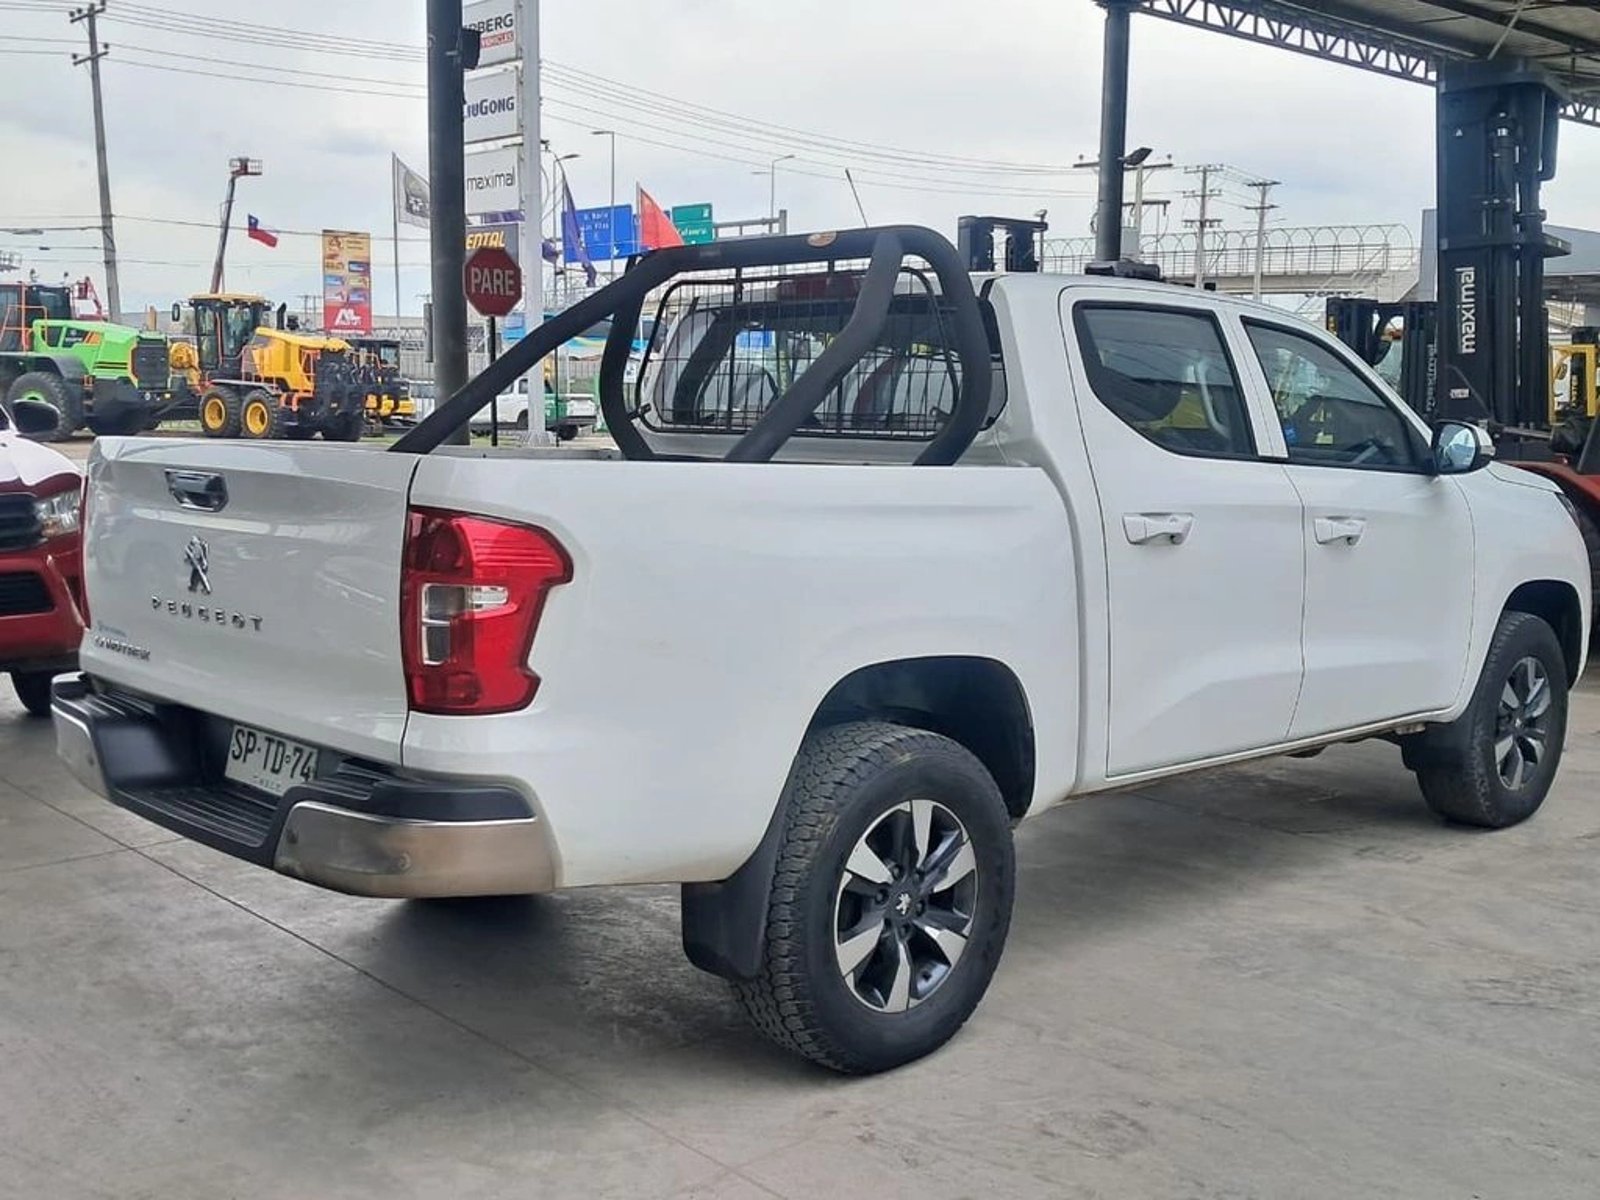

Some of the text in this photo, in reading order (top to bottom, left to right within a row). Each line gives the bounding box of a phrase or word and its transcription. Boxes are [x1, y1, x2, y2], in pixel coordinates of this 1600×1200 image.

[467, 166, 515, 191] maximal
[471, 266, 515, 296] PARE
[1454, 266, 1476, 354] maximal
[151, 594, 263, 632] PEUGEOT
